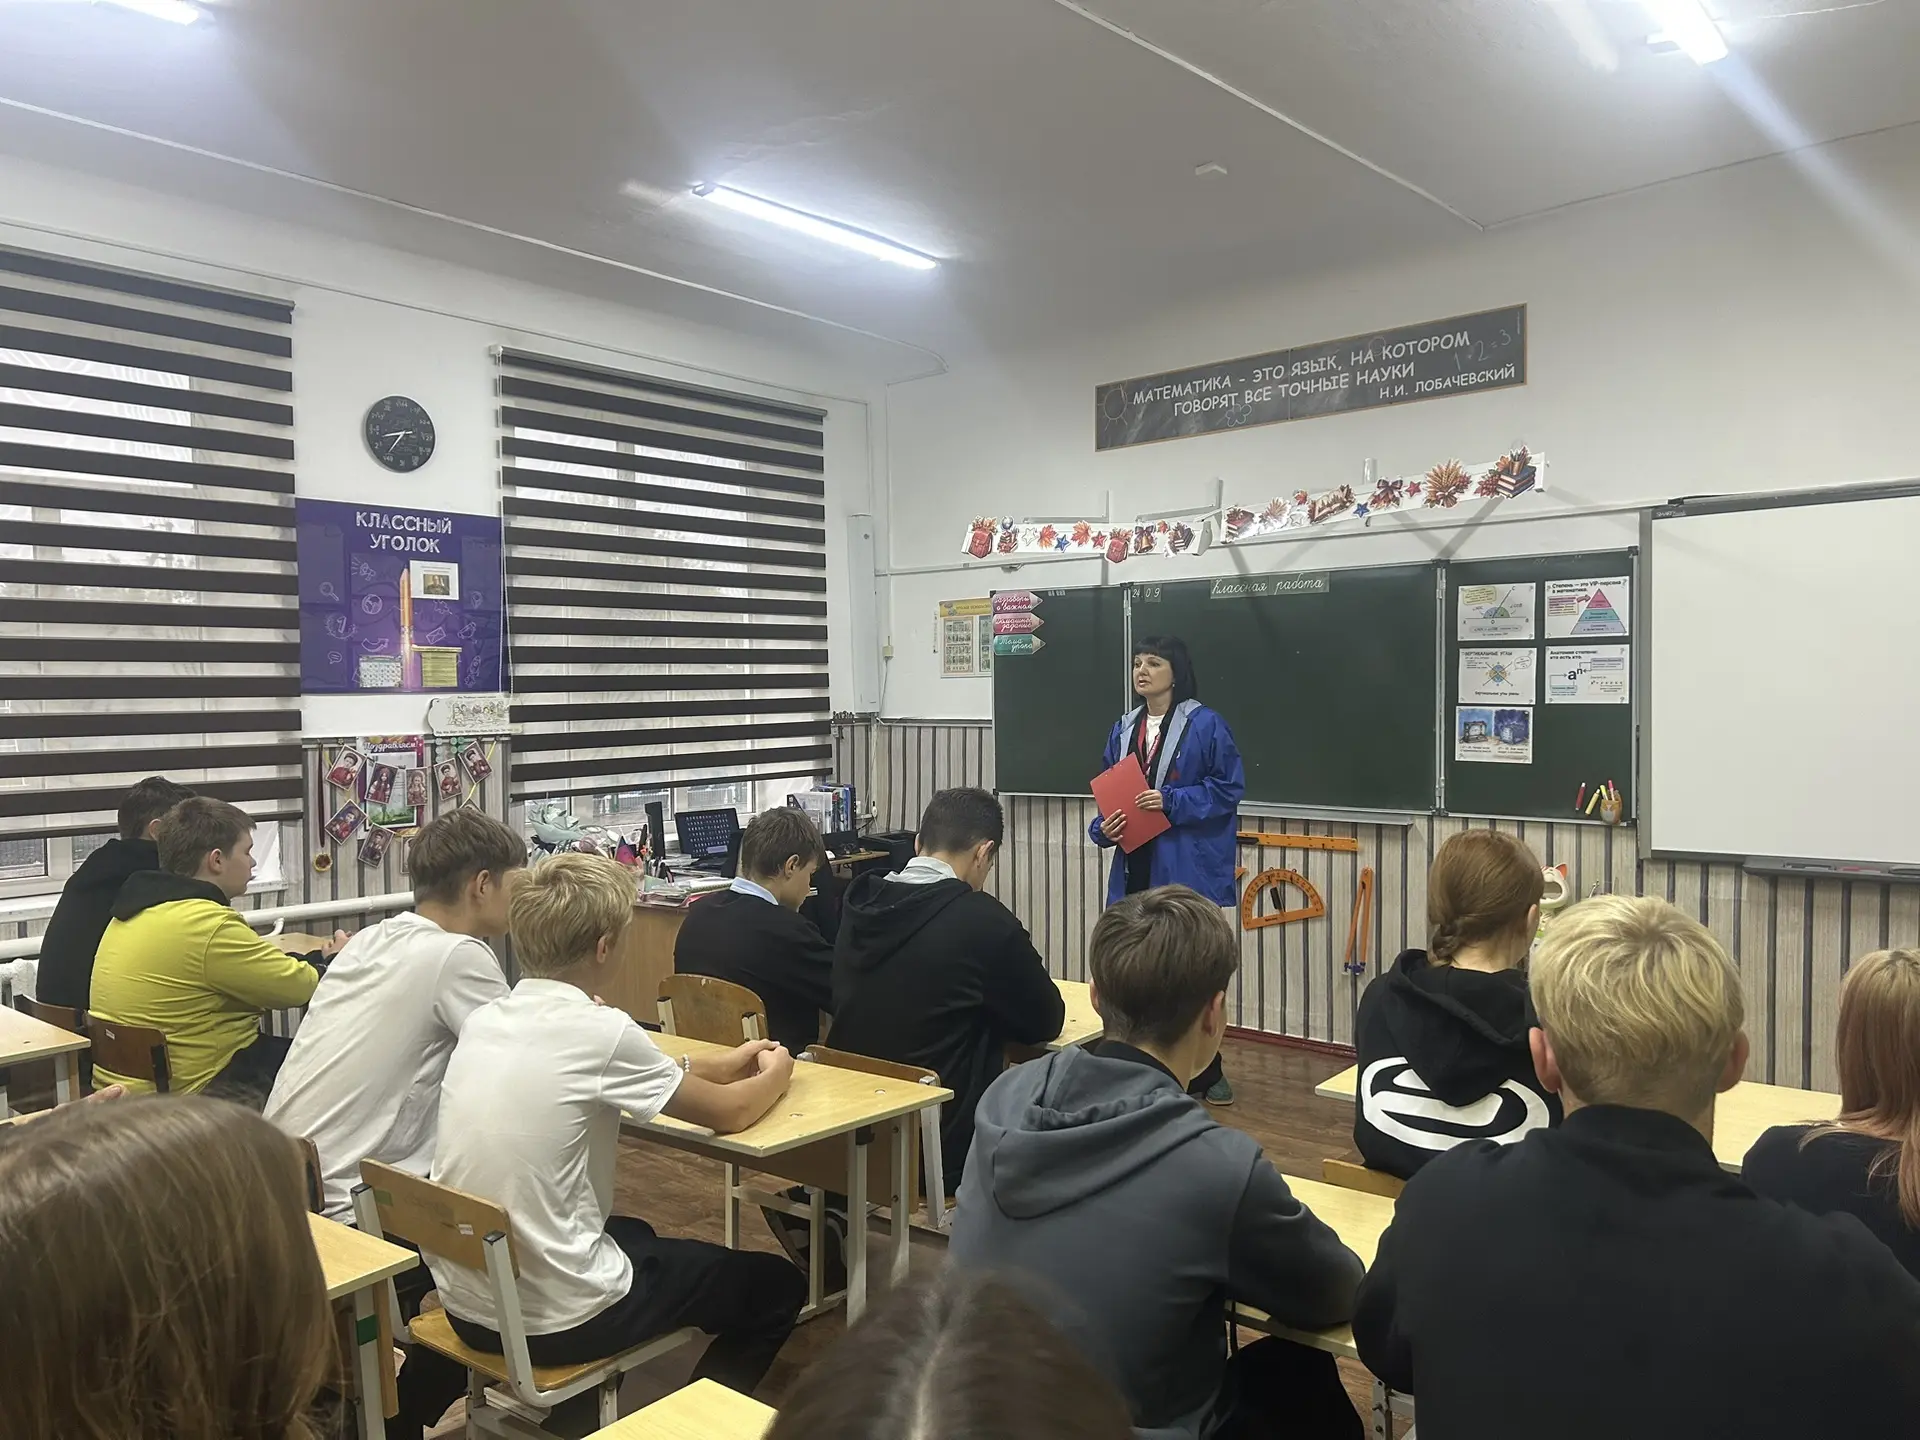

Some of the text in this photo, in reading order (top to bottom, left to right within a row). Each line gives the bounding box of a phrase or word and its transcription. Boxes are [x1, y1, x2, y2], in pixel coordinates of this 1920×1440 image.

[1133, 375, 1232, 405] МАТЕМАТИКА
[1252, 365, 1285, 383] ЭТО
[1291, 355, 1342, 377] ЯЗЫК,
[1350, 350, 1375, 366] НА
[1382, 331, 1470, 360] КОТОРОМ
[1379, 363, 1515, 399] Н.И. ЛОБАЧЕВСКИЙ
[1174, 362, 1415, 416] ГОВОРЯТ ВСЕ ТОЧНЫЕ НАУКИ
[356, 511, 452, 534] КЛАССНЫЙ
[369, 533, 440, 553] УГОЛОК
[1211, 572, 1325, 595] Классная работа
